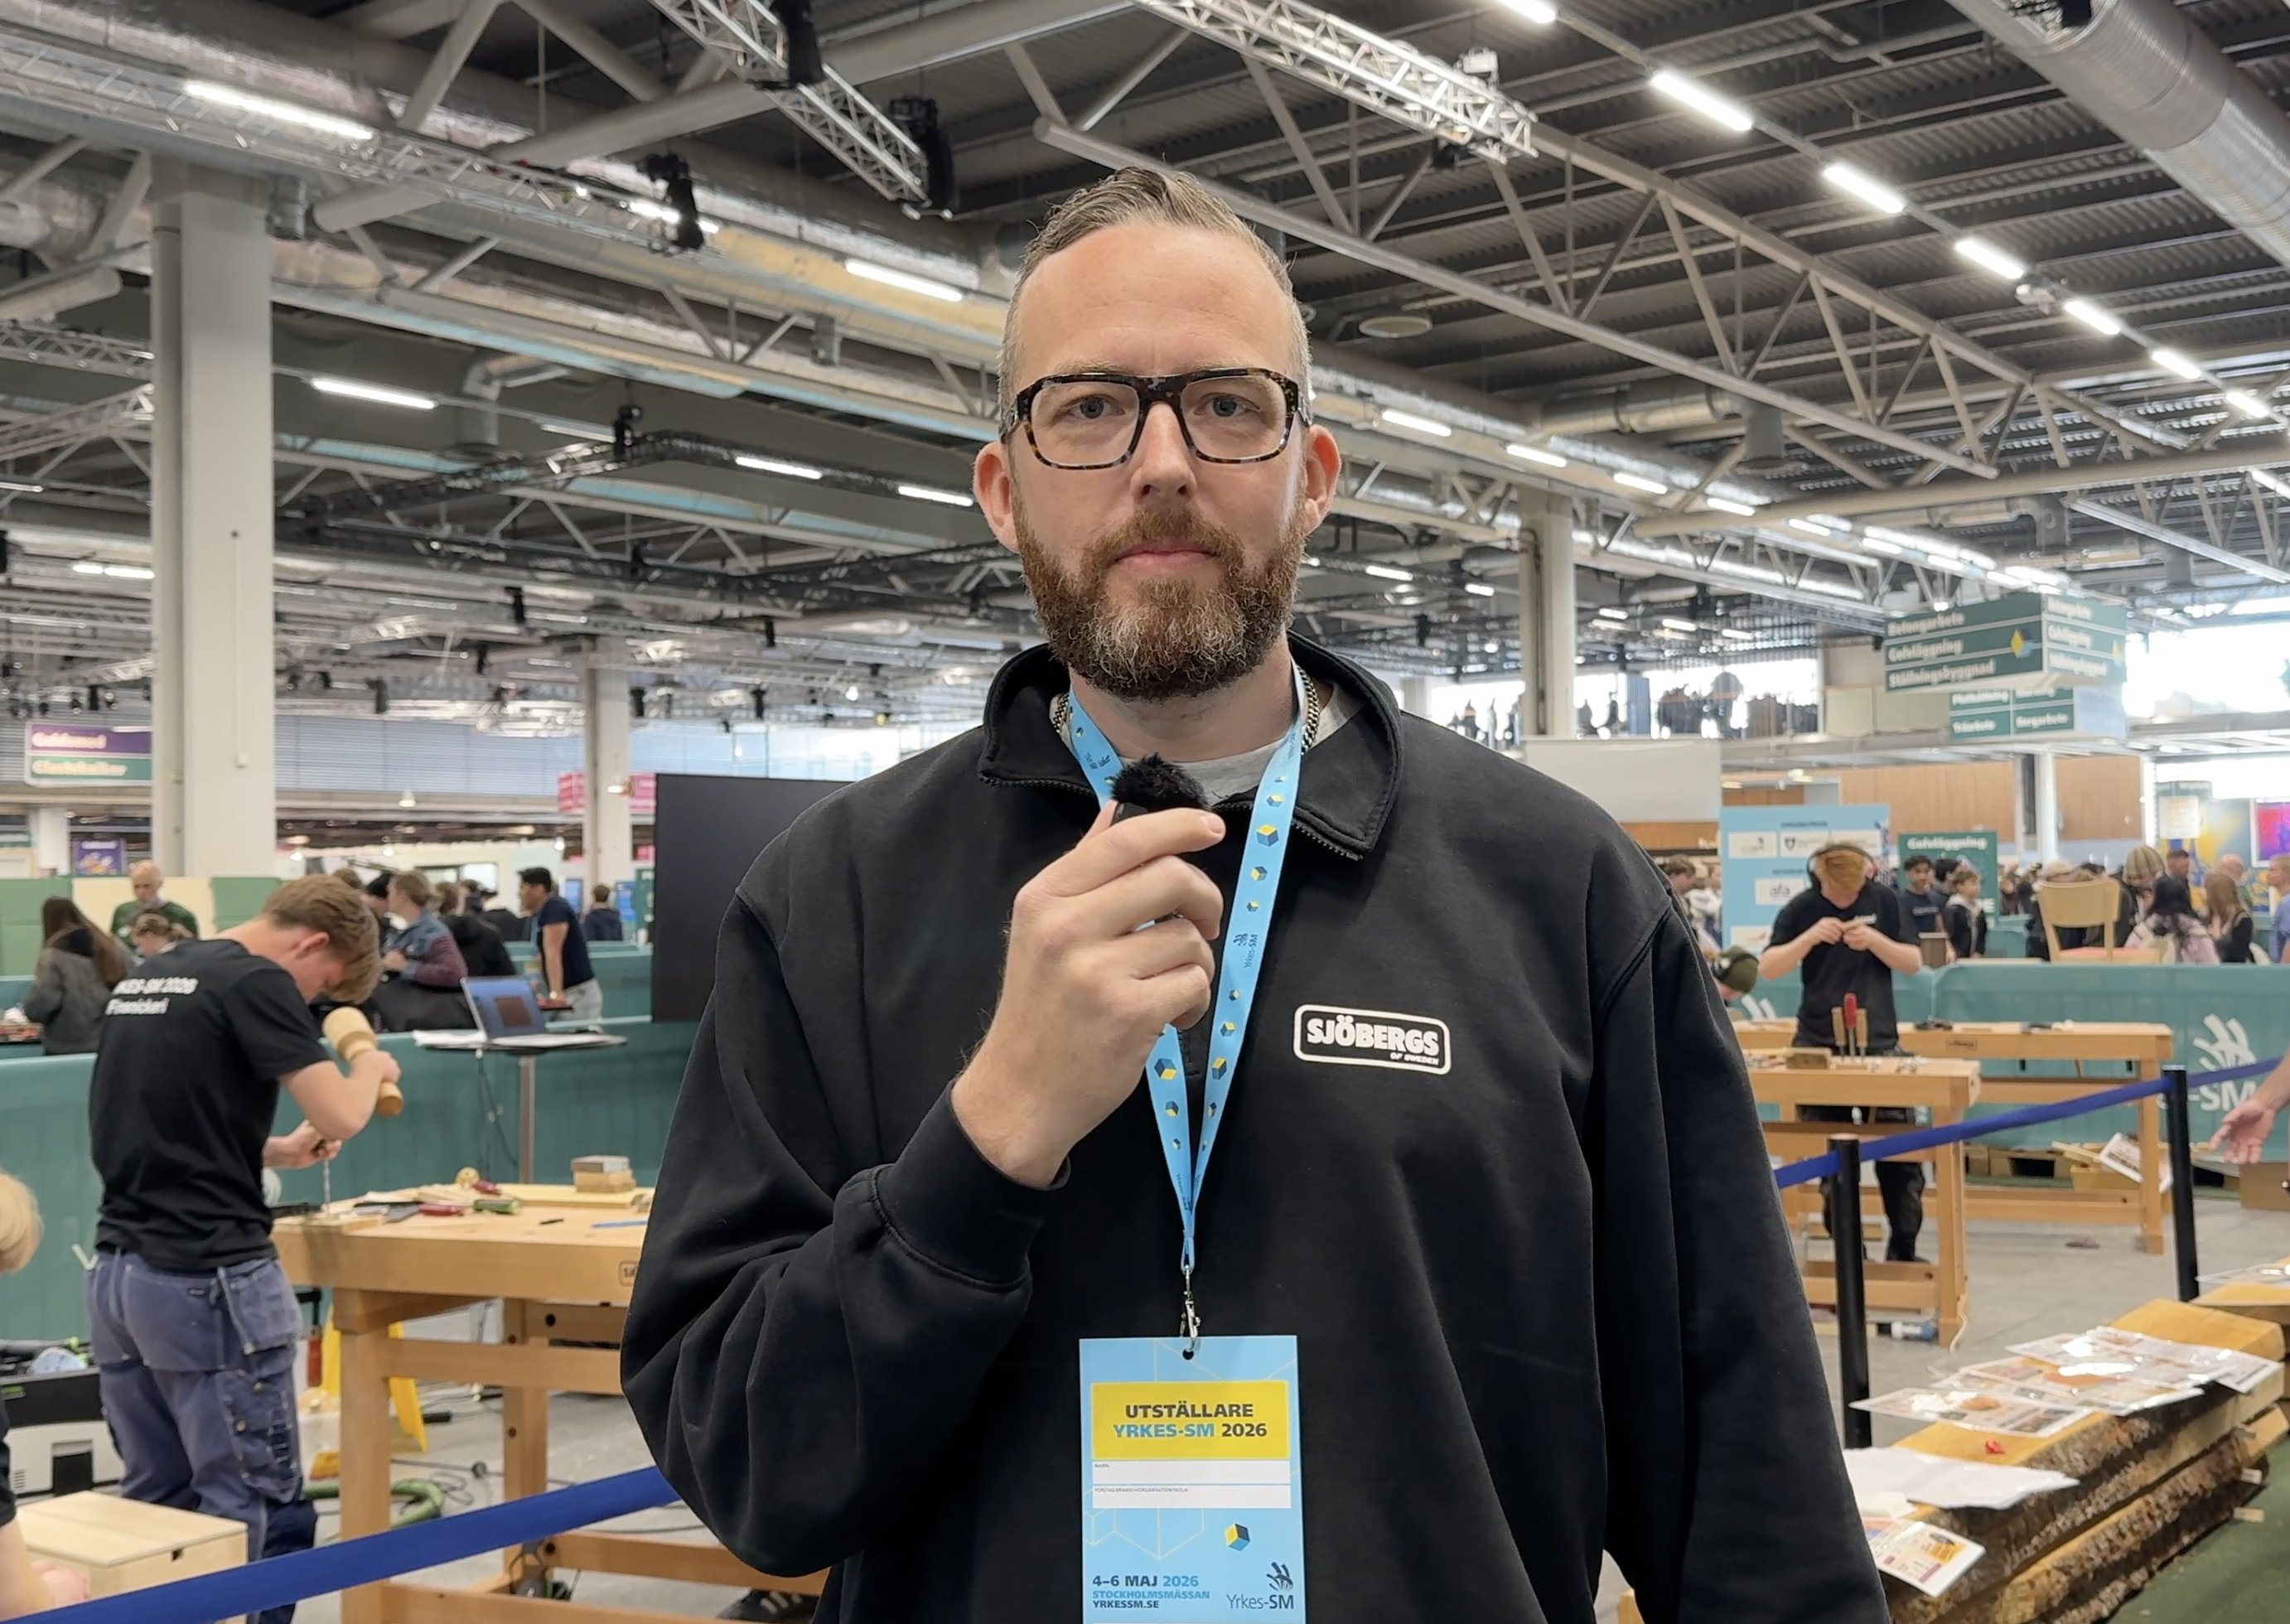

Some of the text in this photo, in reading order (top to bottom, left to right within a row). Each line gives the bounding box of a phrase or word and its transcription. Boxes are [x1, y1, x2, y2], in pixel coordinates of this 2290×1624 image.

[1887, 611, 1965, 636] Betongarbete
[1887, 639, 1964, 662] Golvläggning
[1888, 659, 1996, 688] Ställningsbyggnad
[1243, 934, 1258, 969] Yrkes-SM
[1307, 1014, 1440, 1056] SJÖBERGS
[1403, 1054, 1440, 1066] SWEDEN
[1125, 1400, 1254, 1419] UTSTÄLLARE
[1113, 1423, 1267, 1438] YRKES-SM 2026
[1124, 1575, 1157, 1587] MAJ
[1162, 1575, 1199, 1587] 2026
[1092, 1588, 1210, 1599] STOCKHOLMSMÄSSAN
[1226, 1593, 1295, 1609] Yrkes-SM
[1093, 1600, 1160, 1608] YRKESSM.SE
